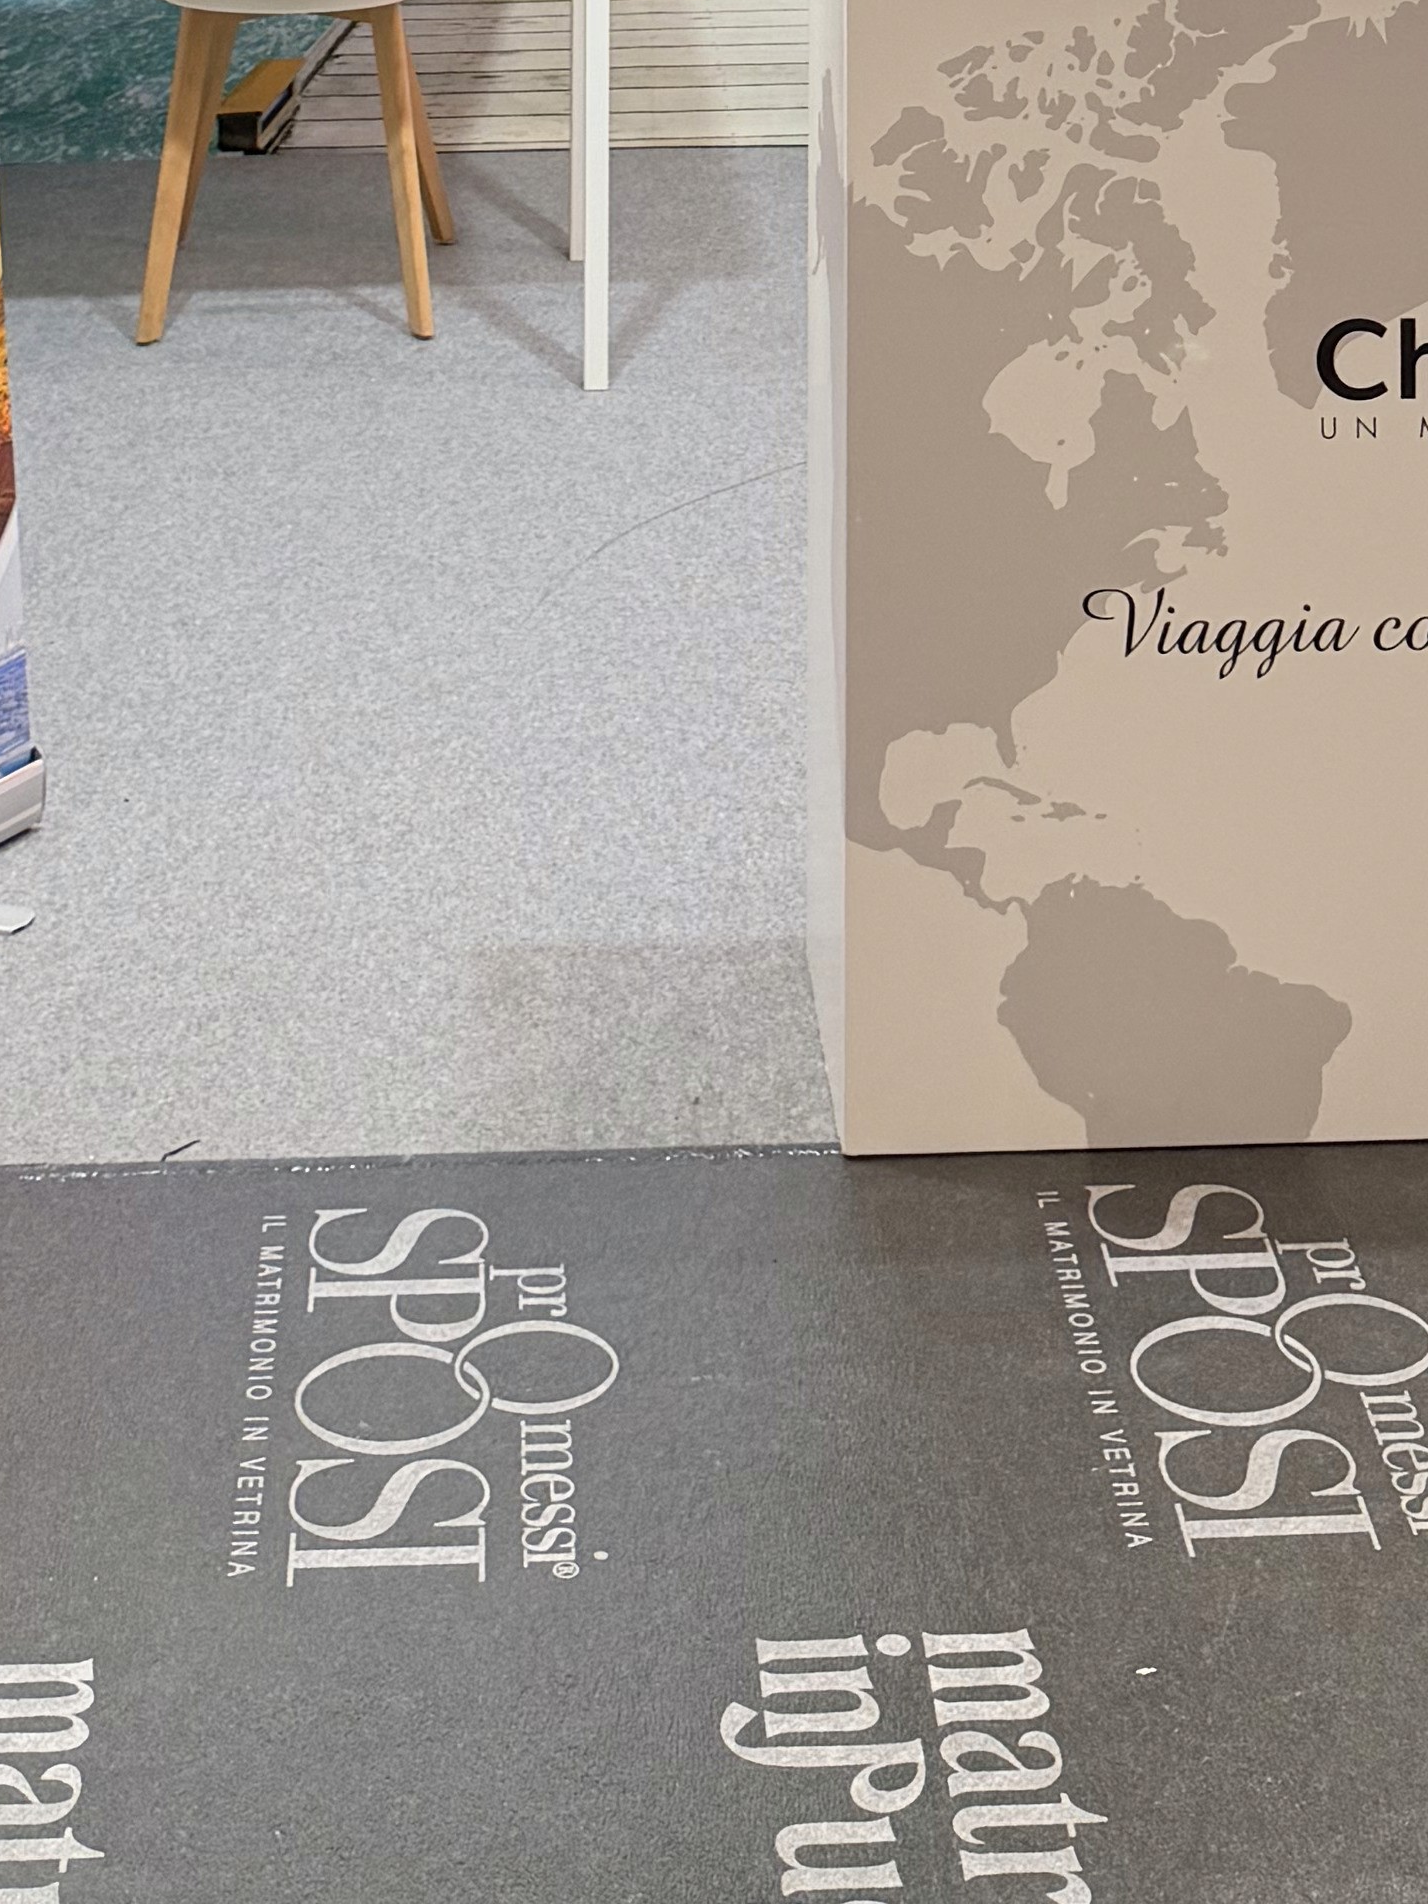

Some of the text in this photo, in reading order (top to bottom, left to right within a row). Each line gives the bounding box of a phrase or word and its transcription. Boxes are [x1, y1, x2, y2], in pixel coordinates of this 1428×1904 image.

[1320, 415, 1379, 440] UN
[1081, 585, 1358, 679] Viaggia
[227, 1215, 287, 1577] IL MATRIMONIO IN VETRINA
[286, 1208, 491, 1587] SPOSI
[1036, 1190, 1153, 1549] IL MATRIMONIO IN VETRINA
[1084, 1184, 1381, 1558] SPOSI
